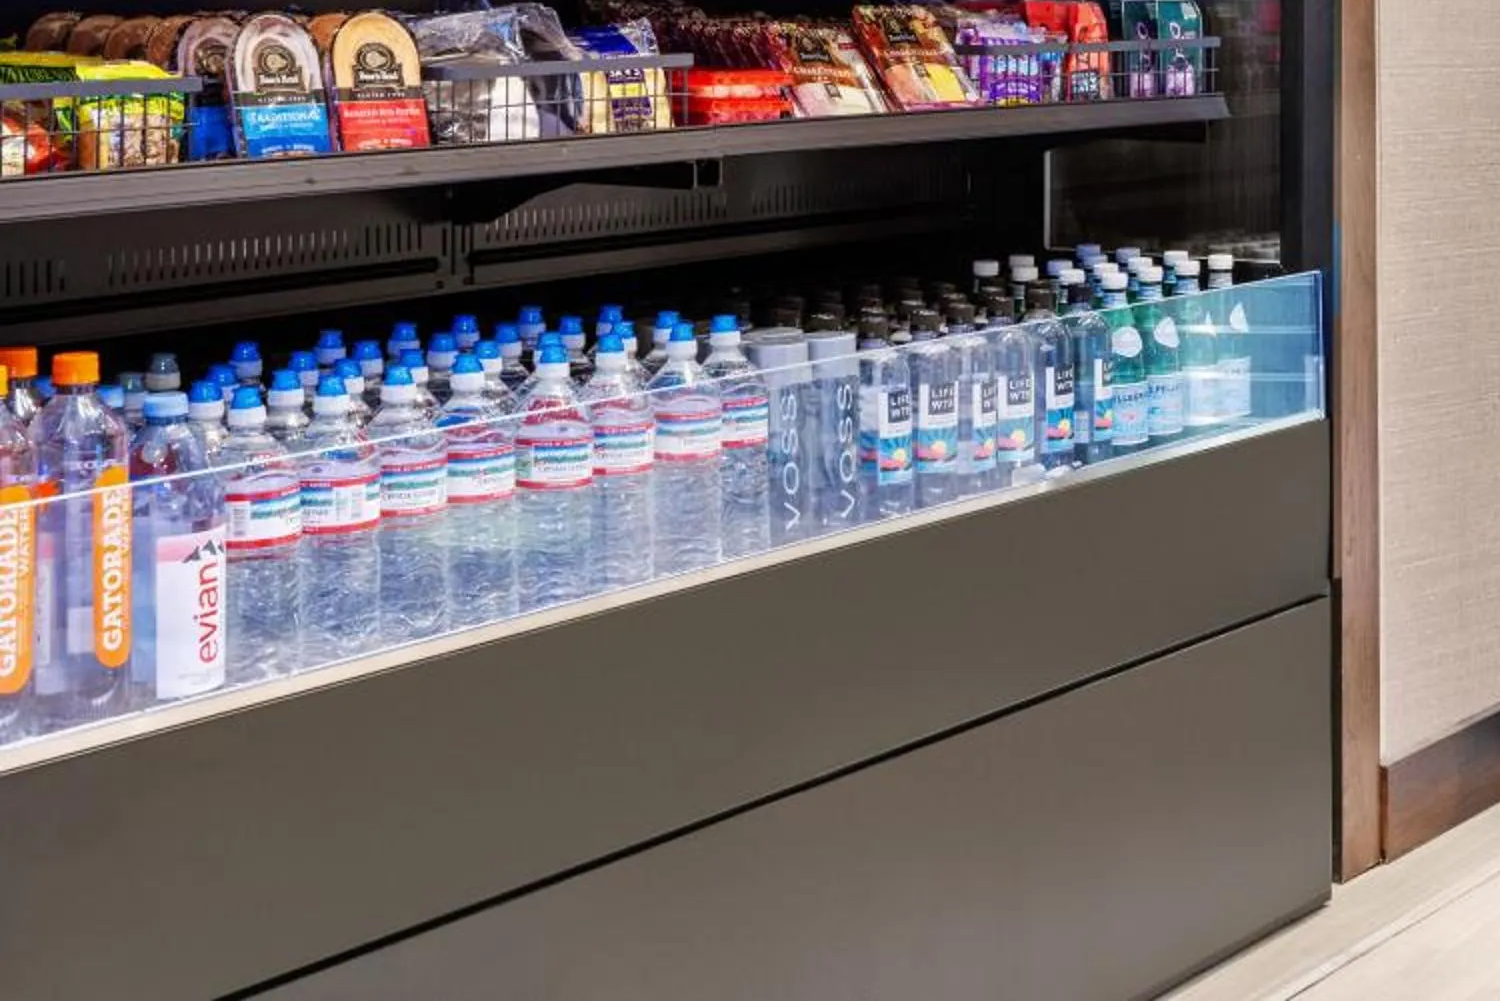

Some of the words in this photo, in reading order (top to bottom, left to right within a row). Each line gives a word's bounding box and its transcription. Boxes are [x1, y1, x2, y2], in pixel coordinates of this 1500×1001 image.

[779, 393, 800, 531] VOSS
[837, 384, 855, 518] VOSS
[103, 486, 123, 650] GATORADE
[193, 562, 218, 663] evian
